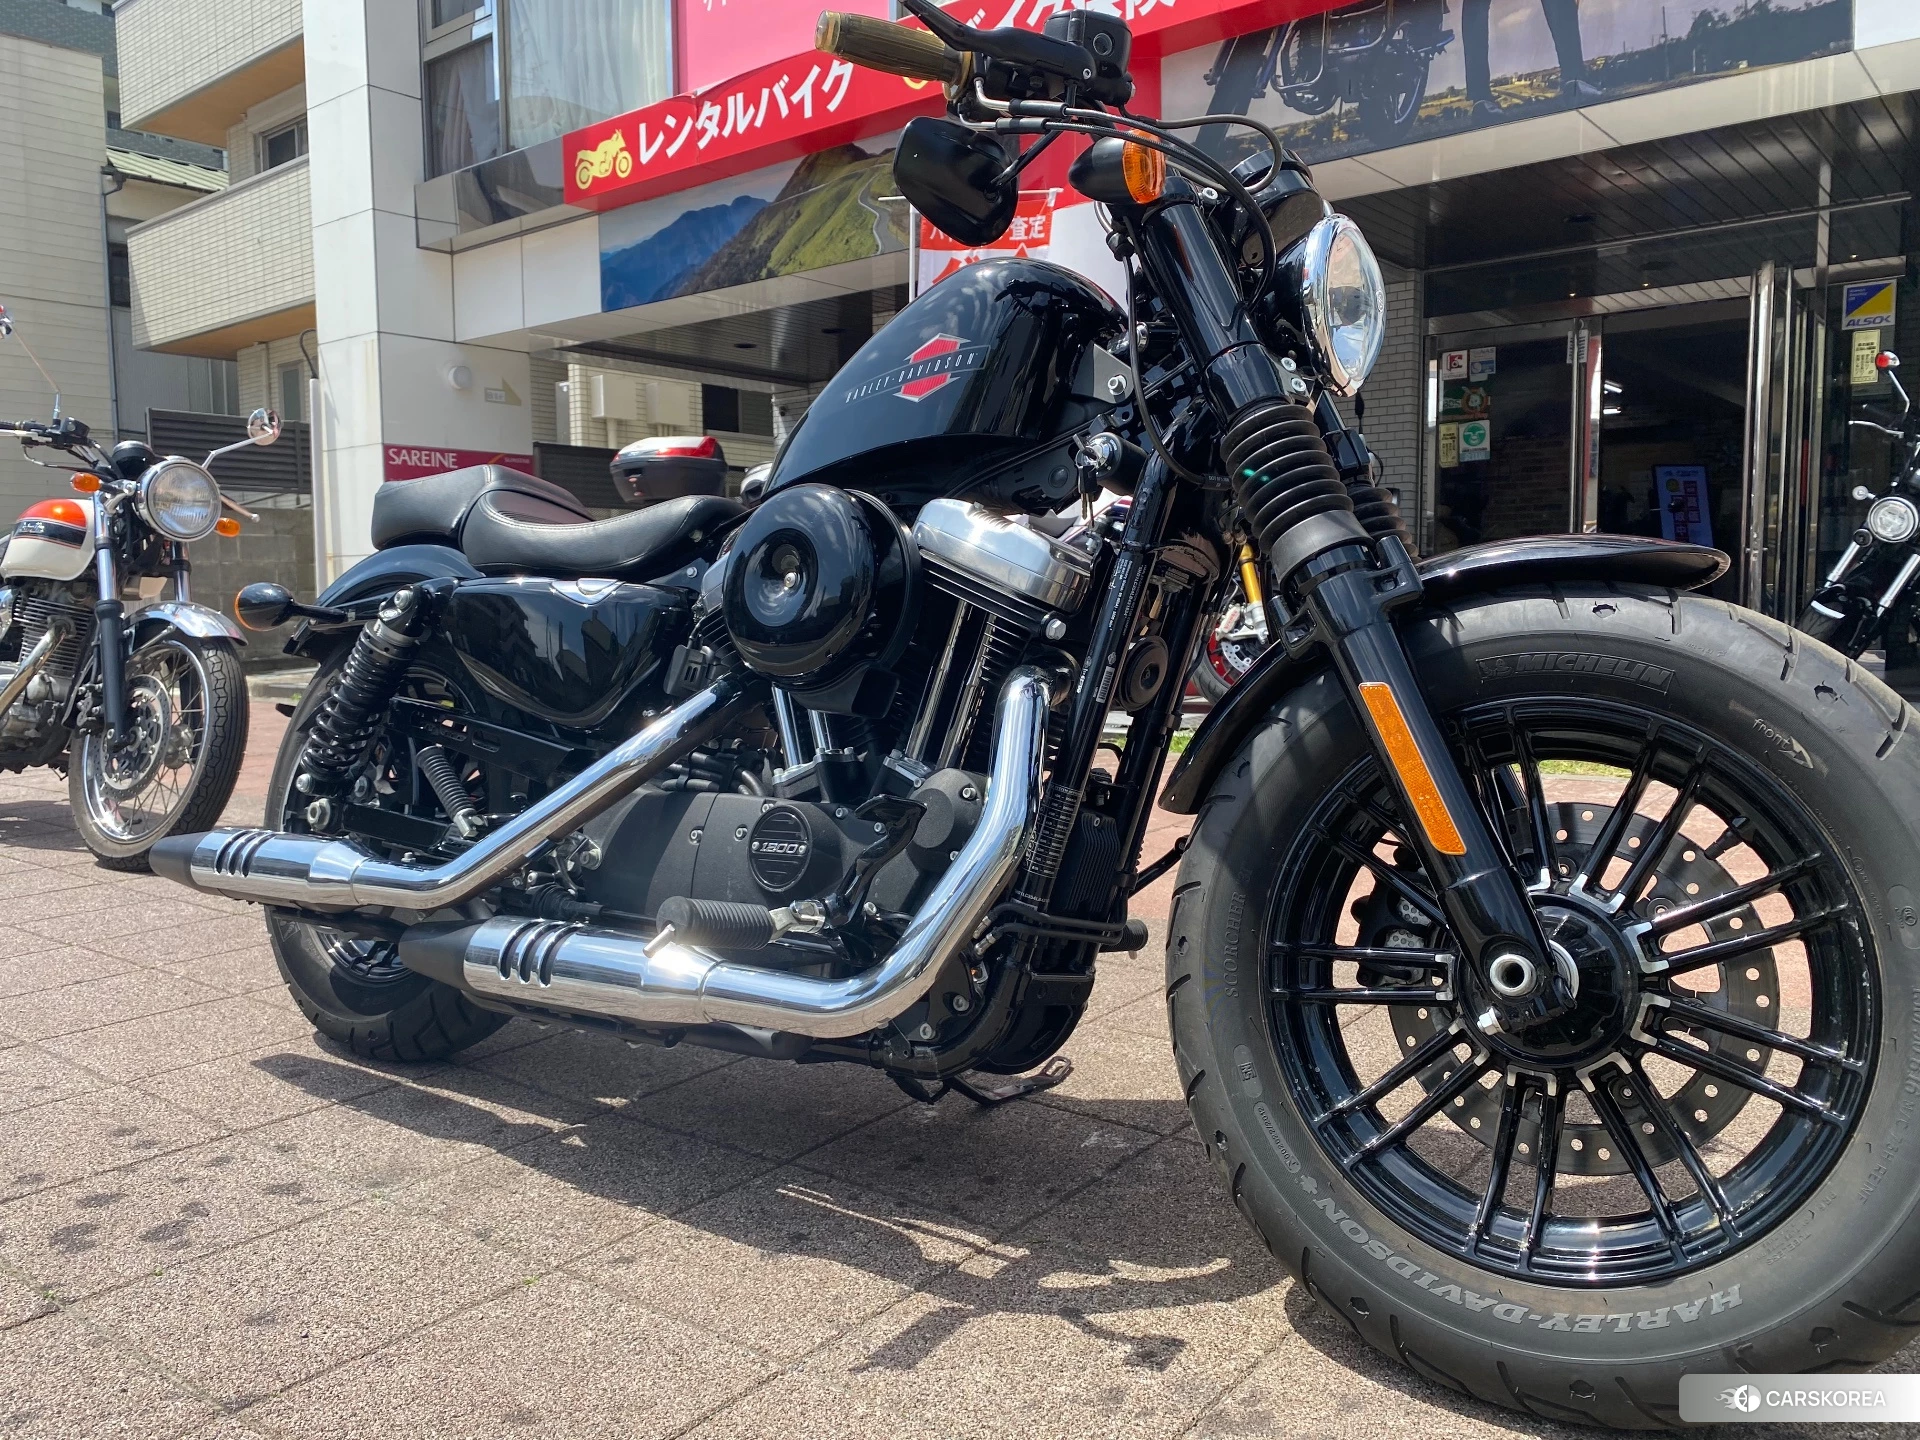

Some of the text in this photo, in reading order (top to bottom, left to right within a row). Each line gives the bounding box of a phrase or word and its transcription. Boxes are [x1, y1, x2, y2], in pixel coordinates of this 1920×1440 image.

[637, 59, 854, 166] レンタルバイク
[1846, 315, 1892, 328] ALSOK
[845, 352, 977, 404] HARLEY-DAVIDSON
[388, 449, 458, 469] SAREINE
[1516, 653, 1671, 686] MICHELIN
[1753, 718, 1790, 749] front
[760, 842, 798, 853] 1200
[1223, 891, 1247, 998] SCORCHER
[1314, 1197, 1744, 1333] HARLEY-DAVIDSON
